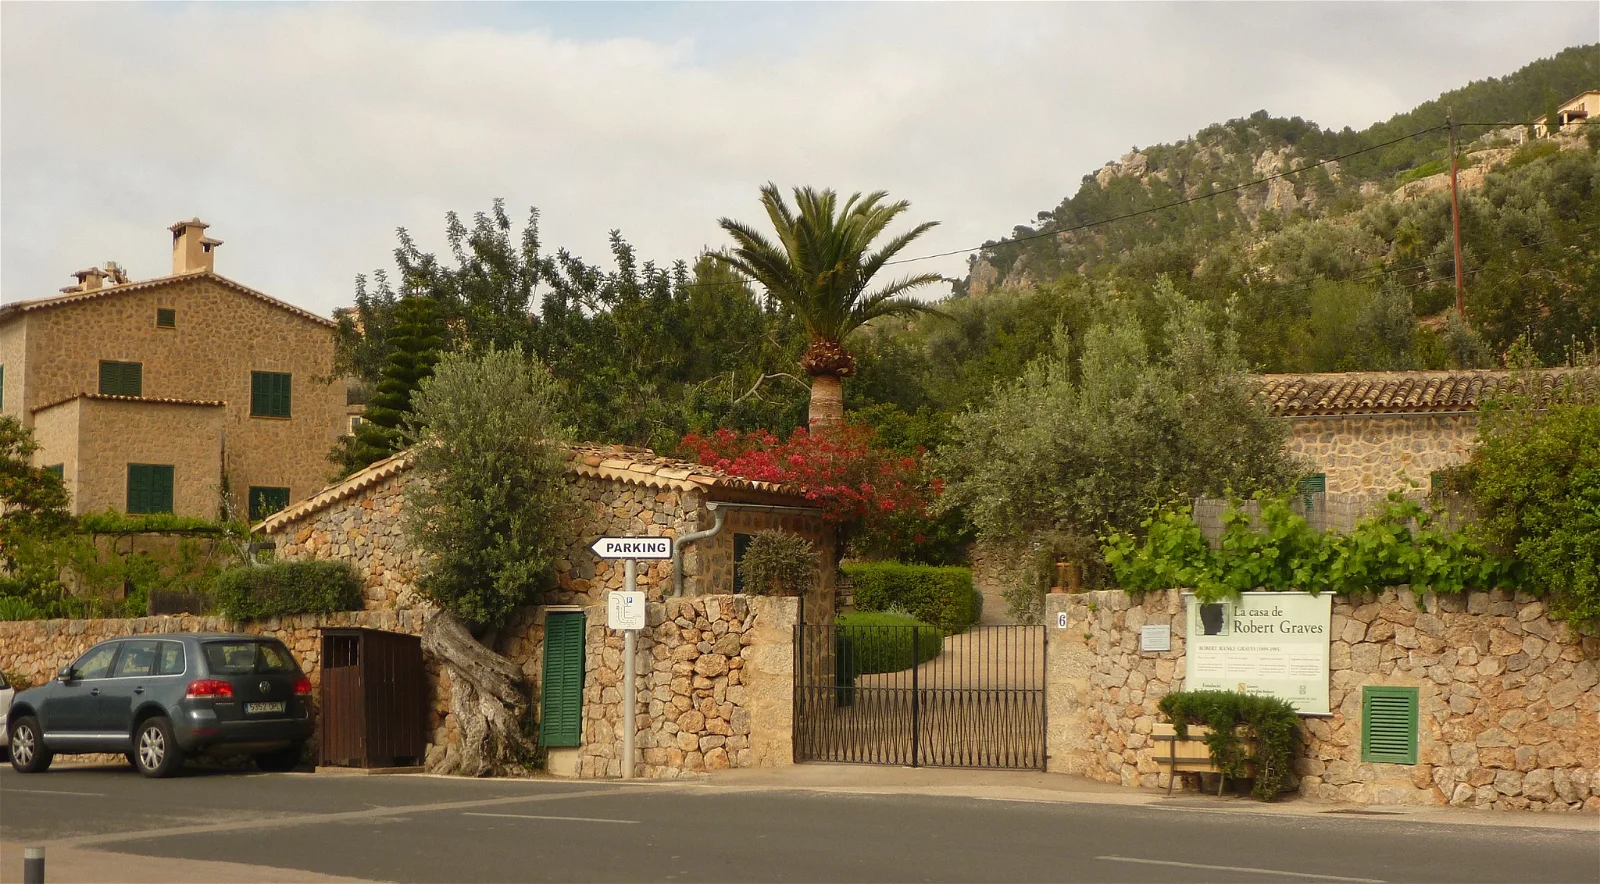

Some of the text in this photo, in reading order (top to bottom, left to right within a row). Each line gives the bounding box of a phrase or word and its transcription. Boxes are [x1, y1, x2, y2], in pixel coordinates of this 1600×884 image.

[606, 543, 666, 553] PARKING
[1233, 606, 1283, 617] La casa de
[1059, 614, 1066, 627] 6
[1233, 620, 1323, 634] Robert Graves
